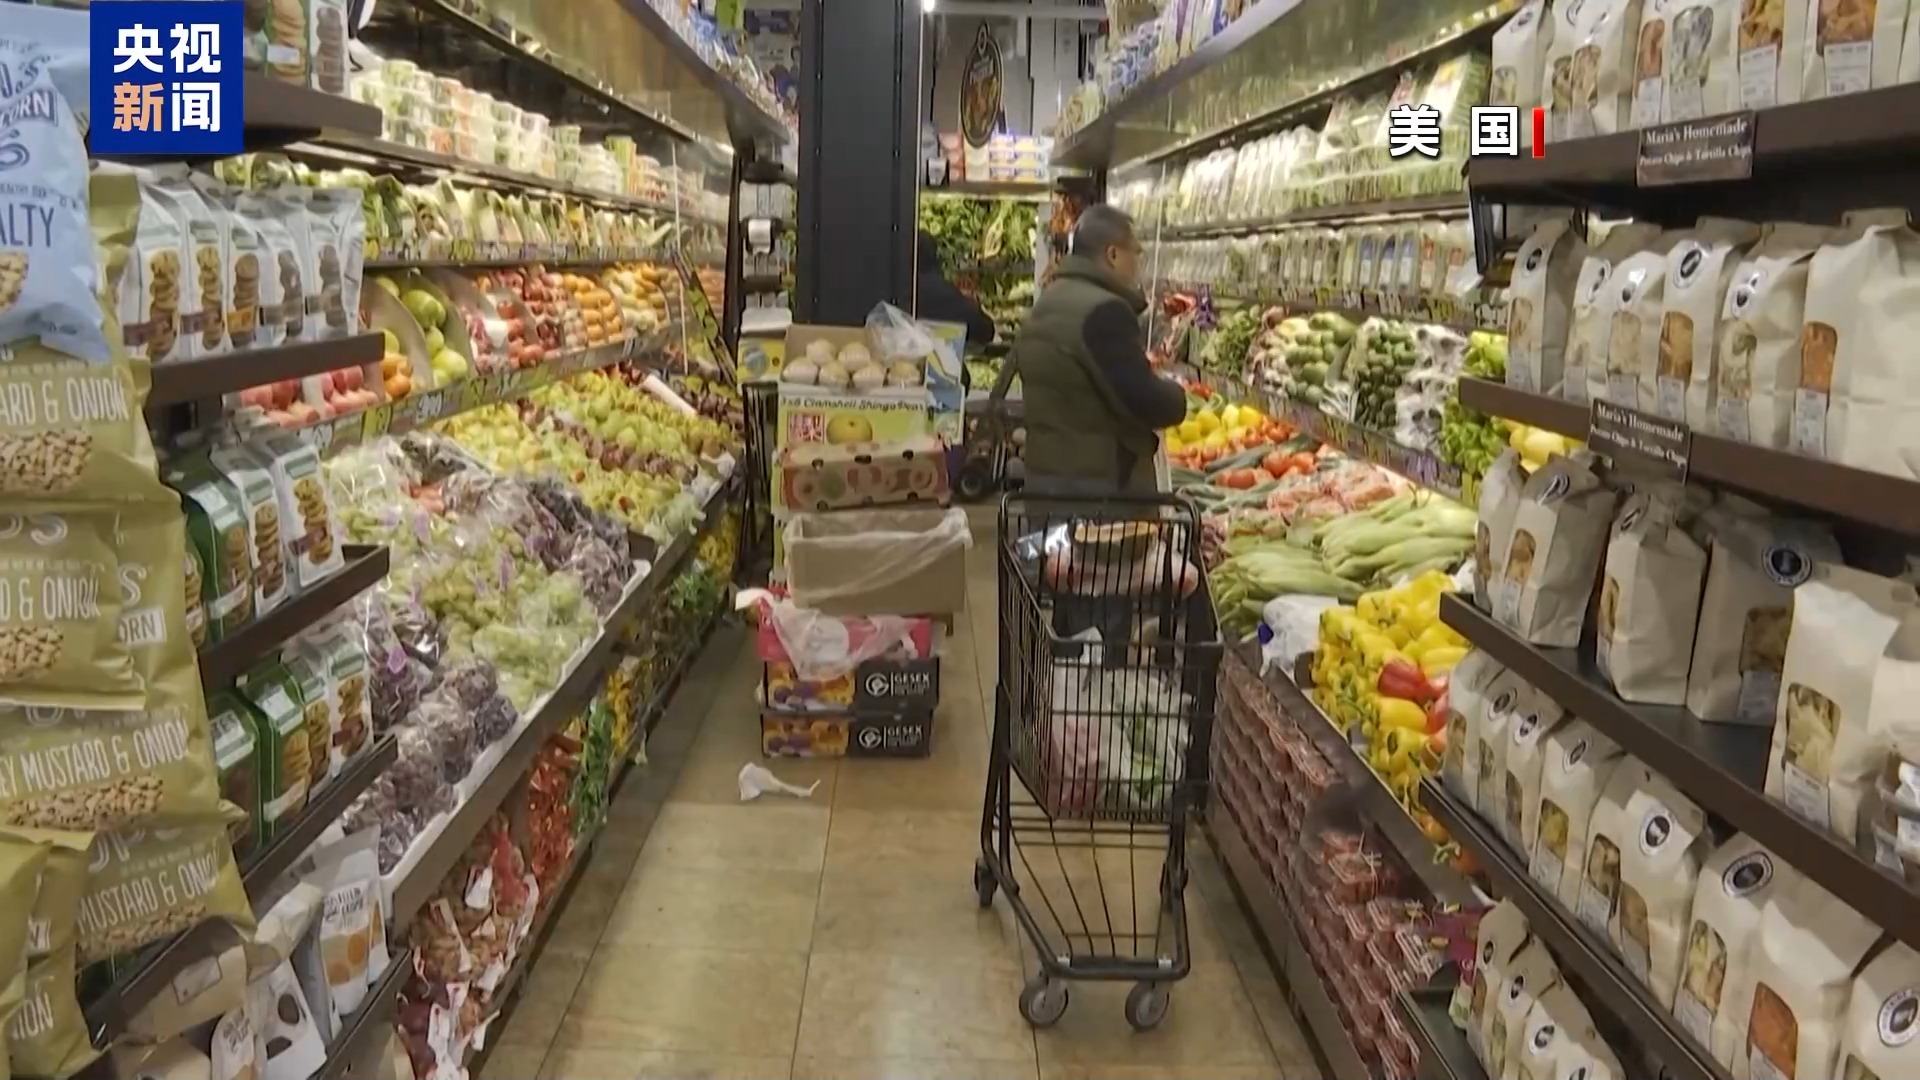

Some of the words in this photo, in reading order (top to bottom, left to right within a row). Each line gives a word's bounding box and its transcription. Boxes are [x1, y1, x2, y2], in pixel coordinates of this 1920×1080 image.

[1646, 129, 1681, 145] Maria's
[1683, 117, 1748, 141] Homemade
[42, 380, 60, 424] &
[67, 376, 129, 423] ONION
[1597, 402, 1628, 425] Maria's
[1629, 412, 1684, 442] Homemade
[20, 737, 111, 793] MUSTARD
[111, 735, 131, 775] &
[77, 876, 159, 936] MUSTARD
[158, 871, 178, 907] &
